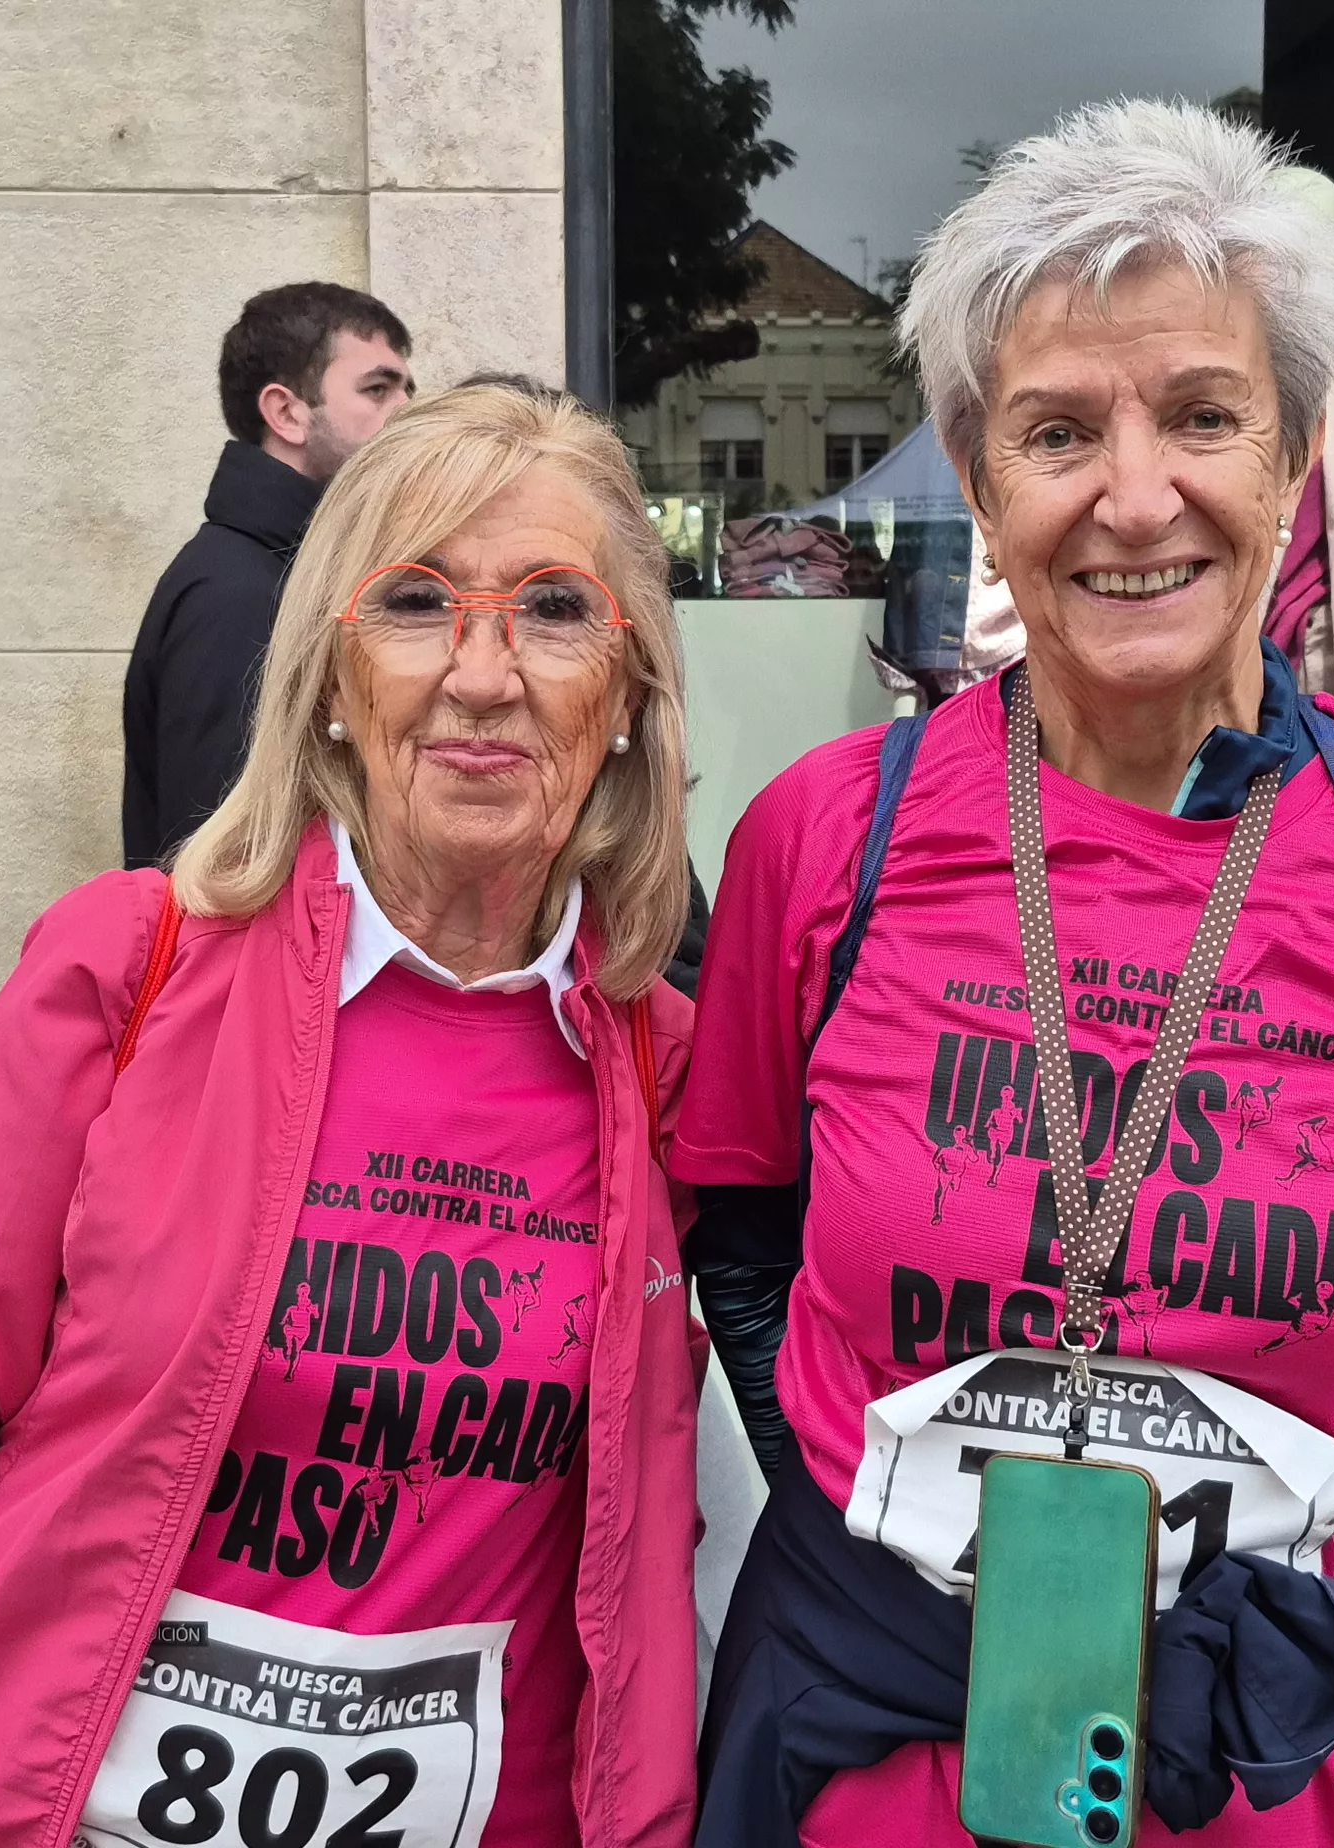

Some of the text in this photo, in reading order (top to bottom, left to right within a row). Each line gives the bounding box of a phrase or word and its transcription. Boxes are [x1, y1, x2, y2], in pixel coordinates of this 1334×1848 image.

[943, 979, 1066, 1018] HUES
[1075, 993, 1200, 1040] CONT
[1209, 1016, 1248, 1045] EL
[1069, 957, 1263, 1015] XII CARERA
[363, 1151, 531, 1202] XII CARRERA
[303, 1180, 599, 1245] SCA CONTRA EL CÁNCE
[1021, 1168, 1133, 1298] E
[269, 1238, 505, 1369] NIDOS
[1053, 1371, 1166, 1409] HUESCA
[315, 1364, 590, 1485] EN CADA
[934, 1389, 1261, 1458] ONTRA EL CÁNC
[151, 1623, 200, 1642] ICIÓN
[133, 1657, 459, 1731] CONTRA EL CÁNCER
[258, 1661, 363, 1697] HUESCA
[138, 1724, 419, 1848] 802
